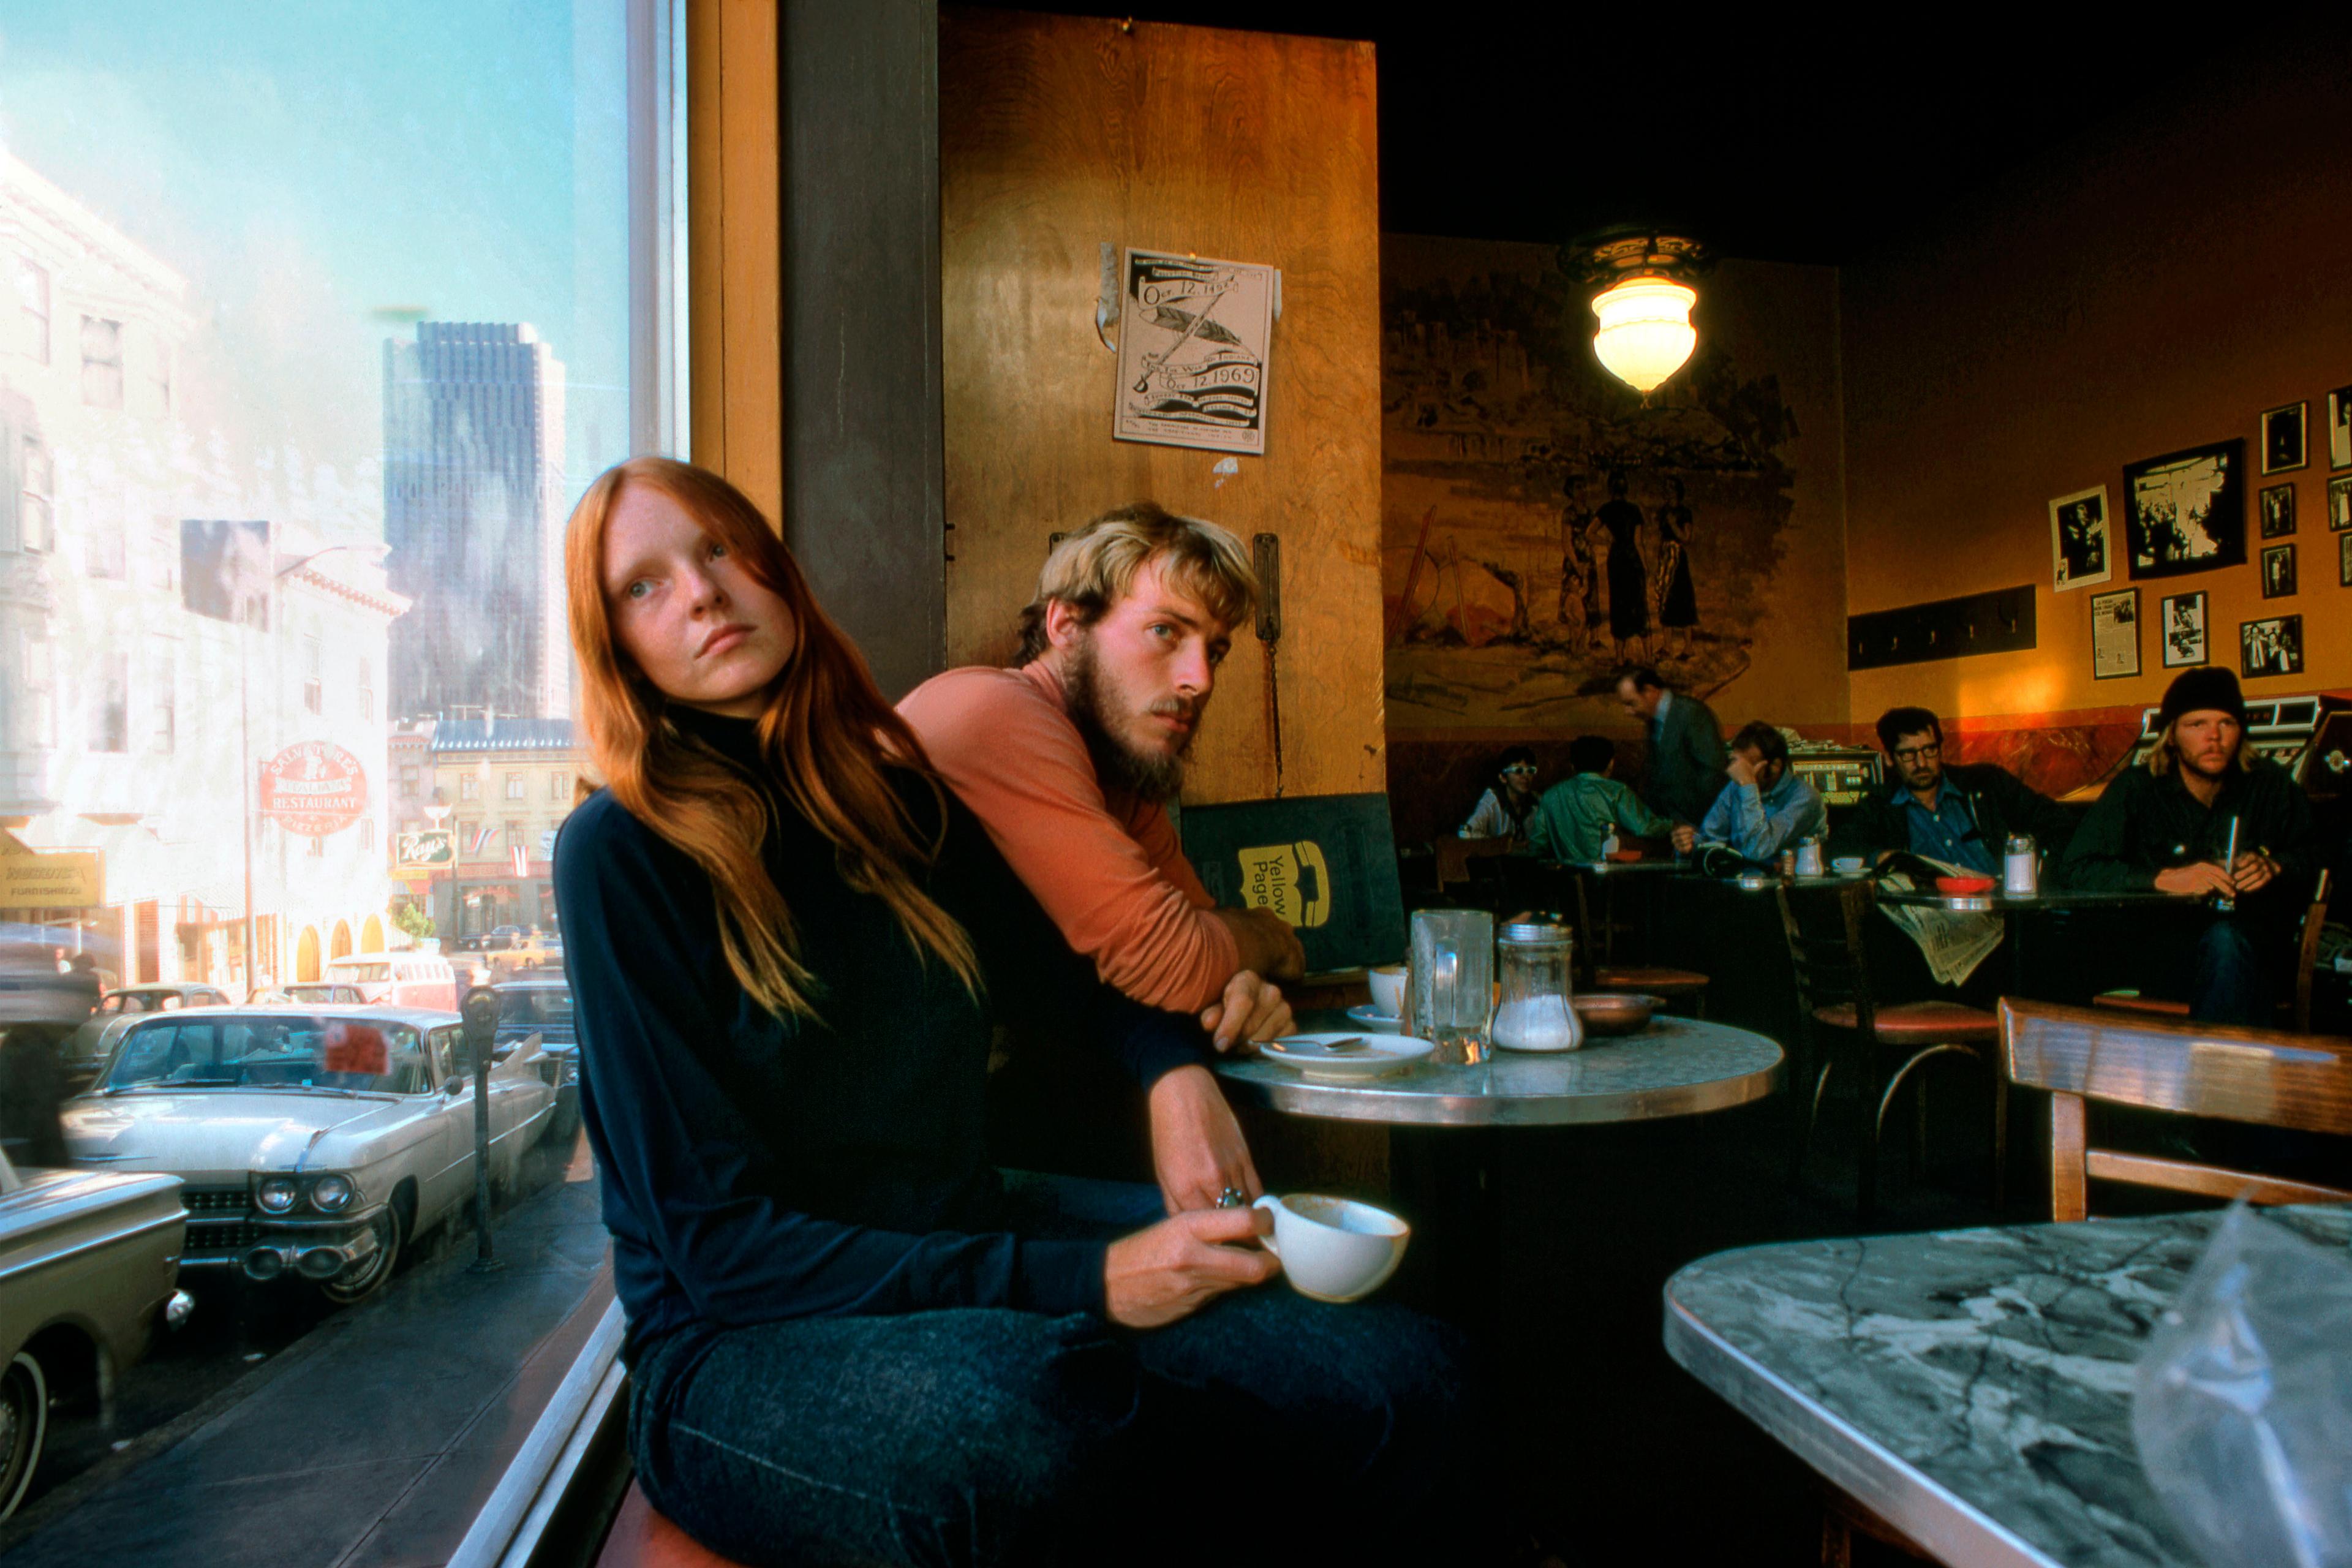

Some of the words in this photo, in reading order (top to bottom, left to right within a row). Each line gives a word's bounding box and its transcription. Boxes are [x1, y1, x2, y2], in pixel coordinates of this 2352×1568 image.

[1213, 368, 1256, 384] 1969
[270, 744, 358, 775] SALVTRE'S
[273, 796, 356, 809] RESTAURANT
[402, 835, 447, 862] Ray's
[1269, 854, 1286, 915] Yellow
